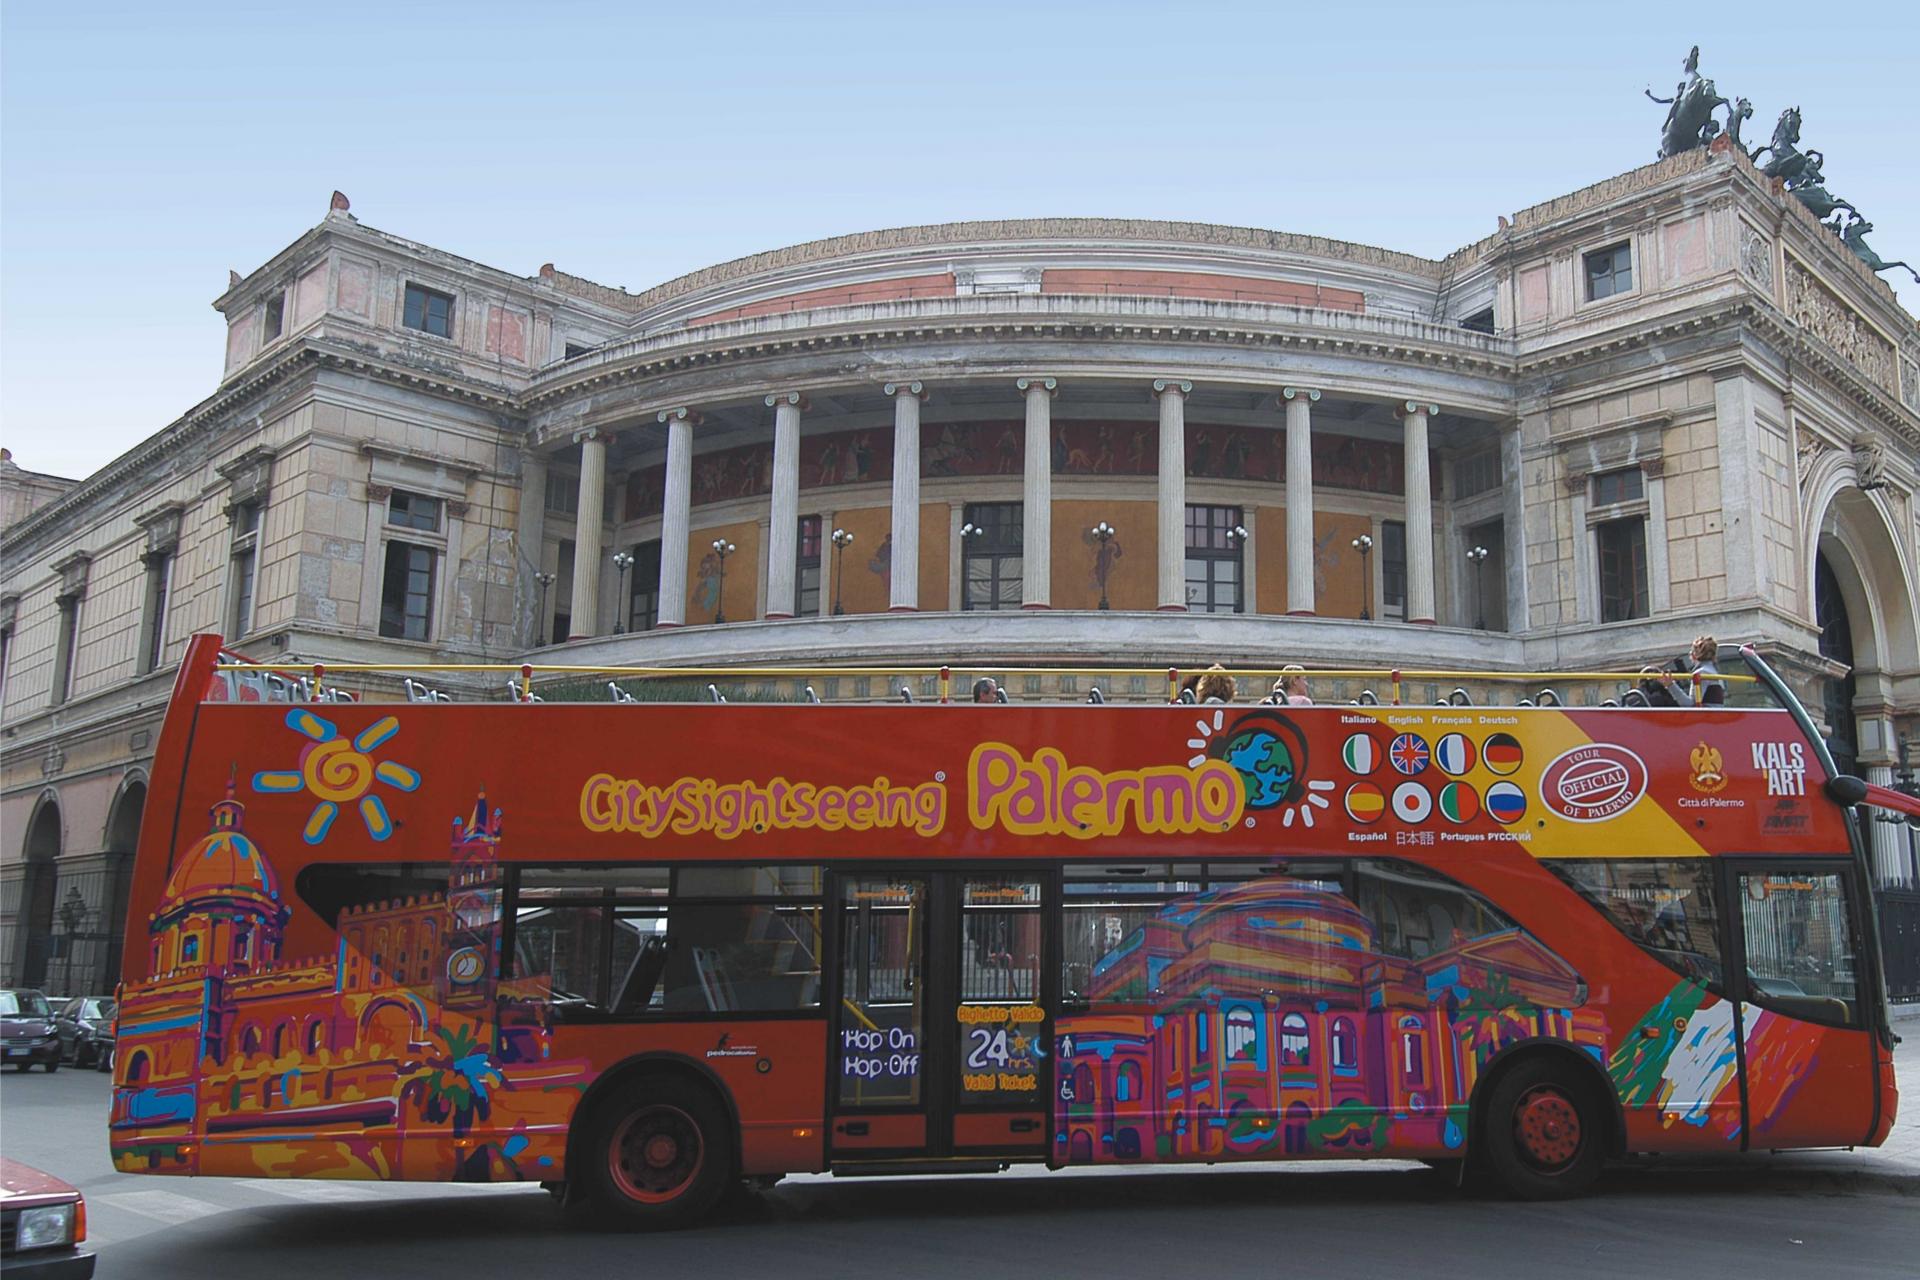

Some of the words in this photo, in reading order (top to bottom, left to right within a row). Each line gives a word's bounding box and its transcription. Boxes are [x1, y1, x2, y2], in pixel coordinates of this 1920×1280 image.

[1341, 714, 1377, 724] Italiano
[1388, 715, 1424, 726] English
[1432, 715, 1472, 726] Français
[1479, 715, 1518, 724] Deutsch
[1566, 749, 1601, 765] TOUR
[1751, 742, 1805, 769] KALS
[580, 773, 946, 840] CitySightseeing
[967, 742, 1245, 840] Palermo
[1562, 770, 1626, 796] OFFICIAL
[1563, 804, 1582, 818] OF
[1588, 790, 1634, 818] PALERMO
[1678, 797, 1700, 808] Città
[1701, 797, 1709, 808] di
[1709, 797, 1745, 808] Palermo
[1348, 832, 1387, 842] Español
[1396, 830, 1435, 846] 日本語
[1440, 832, 1485, 843] Portugues
[1010, 1006, 1045, 1022] Valido
[845, 1029, 883, 1052] Hop
[889, 1027, 914, 1049] On
[968, 1029, 1009, 1068] 24
[845, 1056, 883, 1078] Hop
[889, 1054, 919, 1076] Off
[963, 1073, 996, 1091] Valid
[998, 1072, 1038, 1091] Ticket
